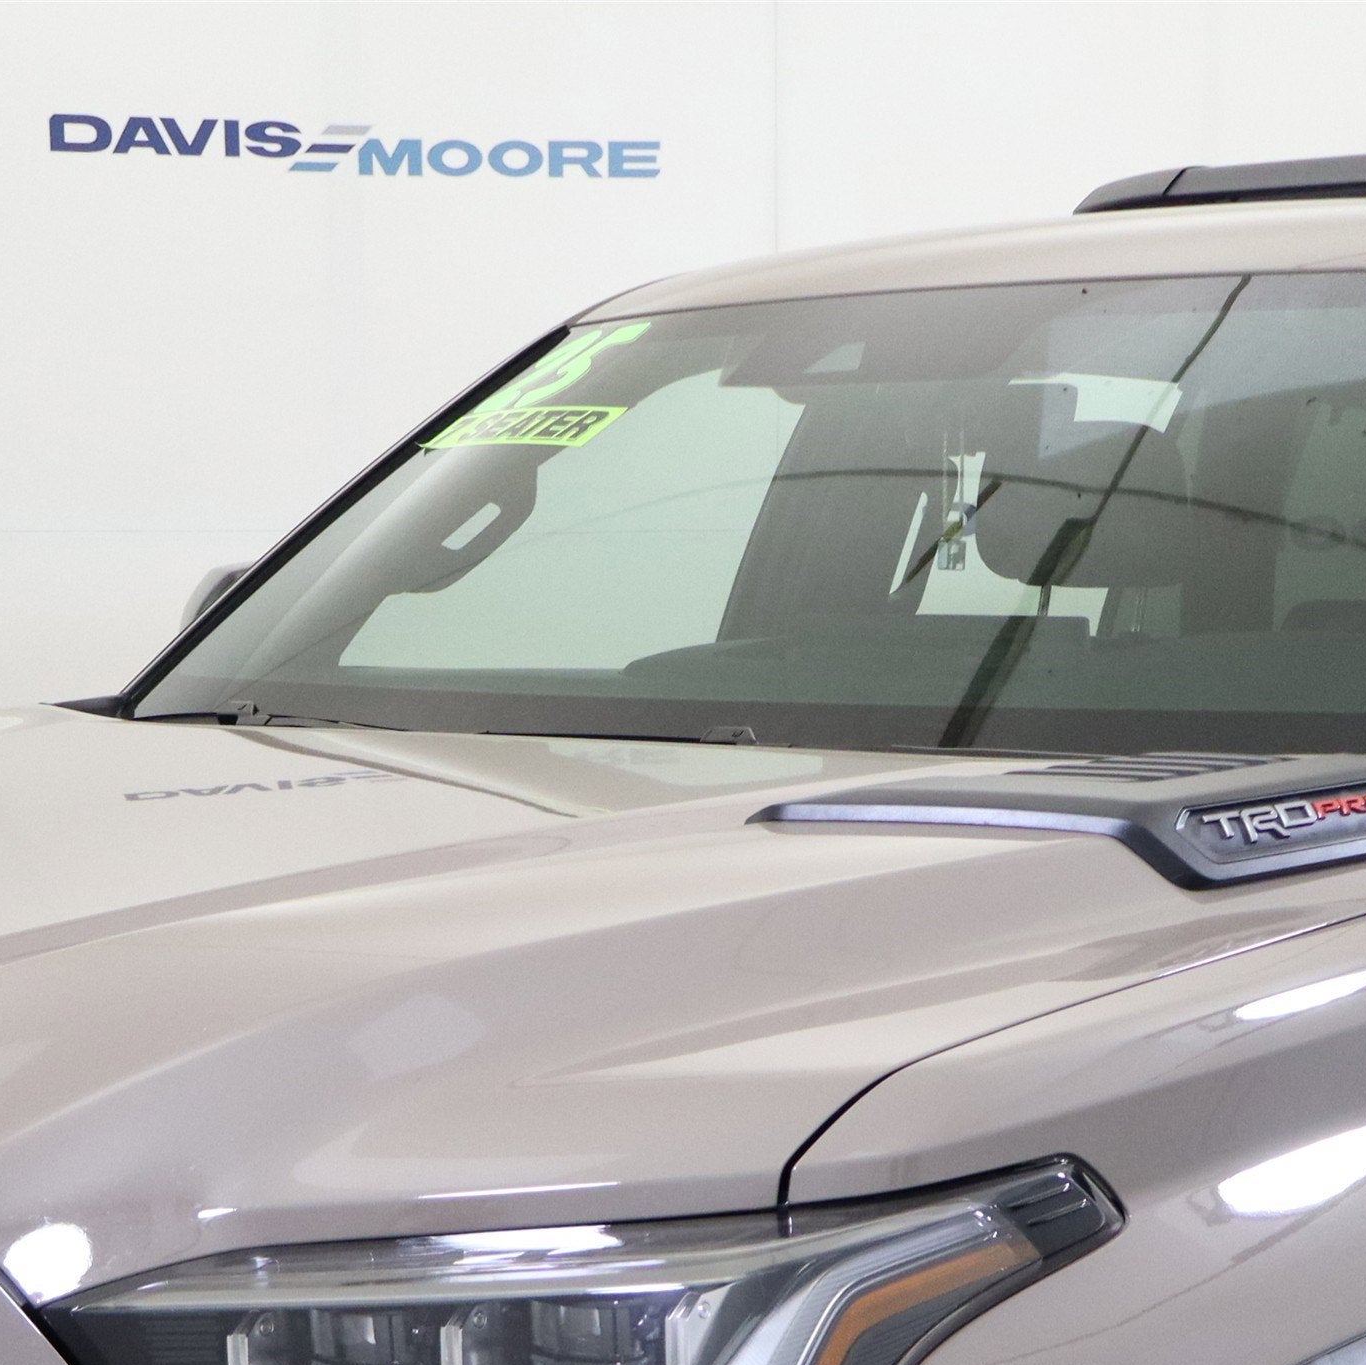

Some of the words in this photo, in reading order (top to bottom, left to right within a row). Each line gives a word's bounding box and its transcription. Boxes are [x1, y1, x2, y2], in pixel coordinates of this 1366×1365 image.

[48, 113, 302, 158] DAVIS
[357, 138, 661, 179] MOORE
[457, 410, 610, 441] SEATER
[1201, 800, 1319, 844] TRD
